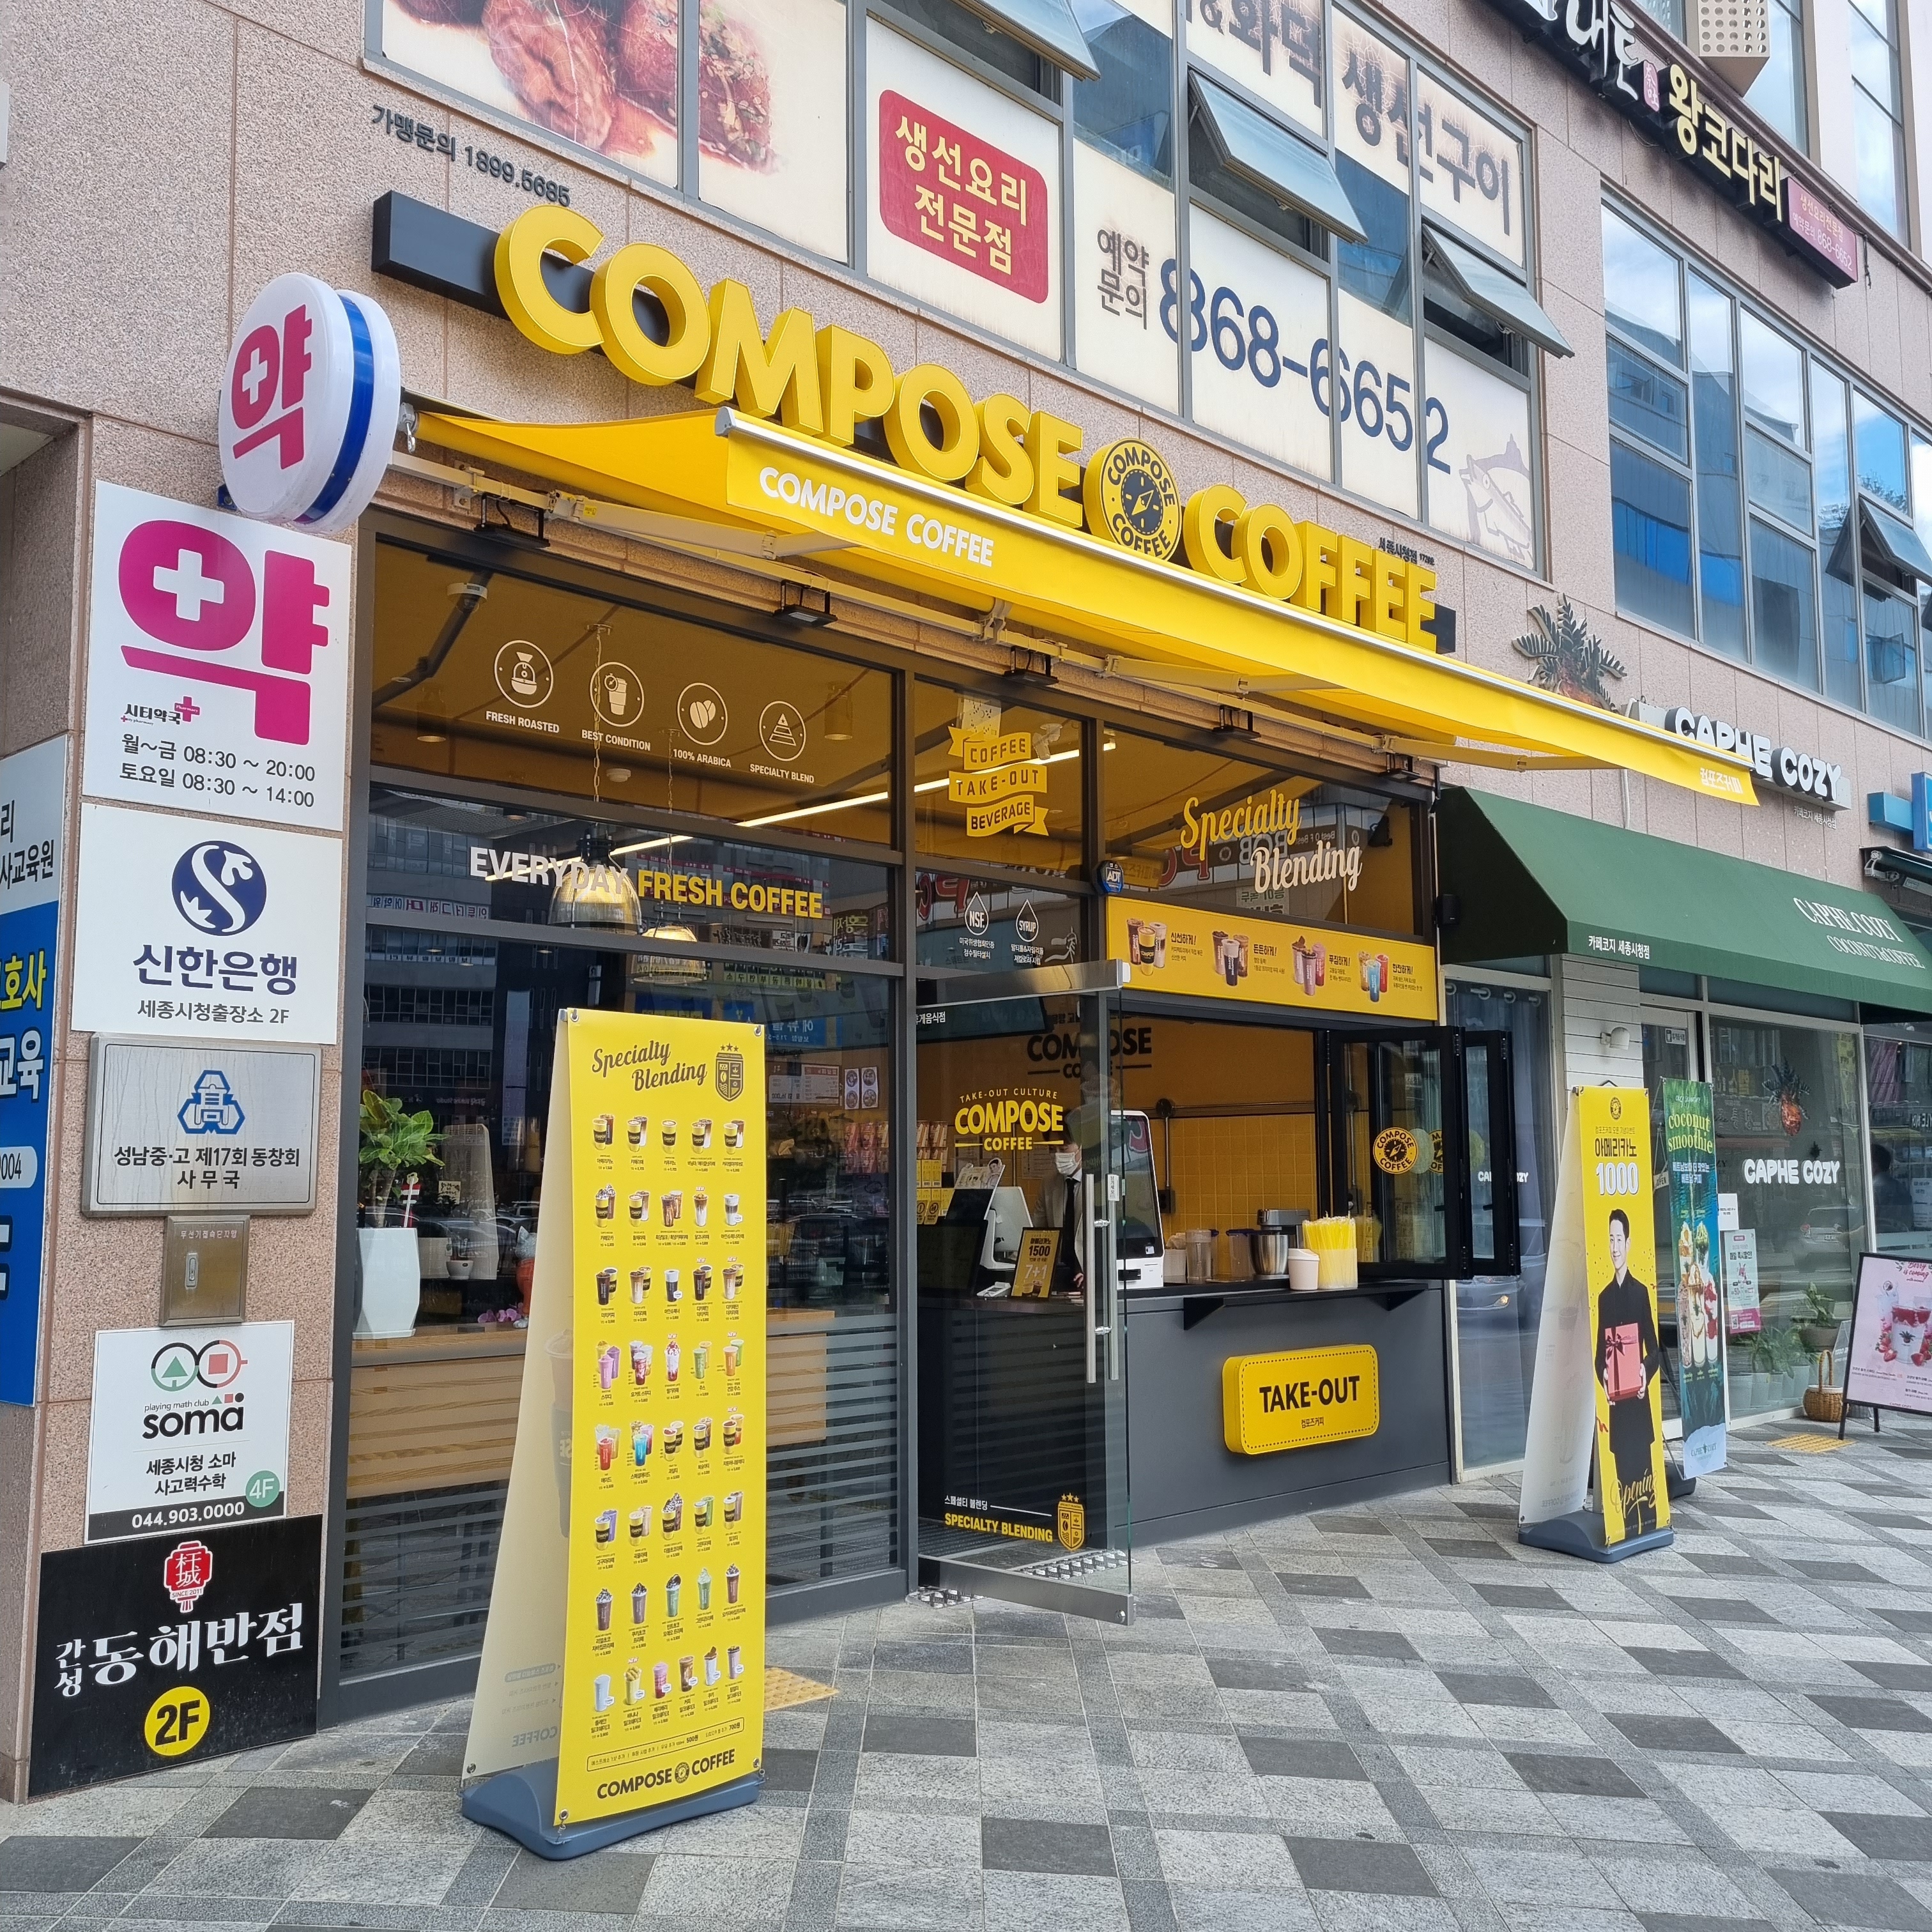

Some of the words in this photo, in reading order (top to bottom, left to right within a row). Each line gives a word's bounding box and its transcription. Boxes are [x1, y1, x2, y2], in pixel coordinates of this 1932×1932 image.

[372, 104, 456, 161] 가맹문의
[464, 145, 571, 207] 1899.5685
[1669, 64, 1782, 222] 왕코다리
[896, 116, 1027, 226] 생선요리
[915, 185, 1013, 275] 전문점
[1800, 194, 1843, 242] 생선요리전문점
[1097, 229, 1149, 281] 예약
[1793, 212, 1816, 241] 예약문의
[1818, 229, 1852, 271] 868-6652
[1097, 267, 1147, 330] 문의
[1159, 258, 1451, 474] 868-6652
[231, 304, 312, 470] 약
[494, 204, 1083, 530] COMPOSE
[1182, 484, 1437, 652] COFFEE
[1108, 446, 1176, 507] COMPOSE
[759, 466, 898, 535] COMPOSE
[906, 514, 994, 567] COFFEE
[1112, 513, 1171, 557] COFFEE
[118, 519, 330, 745] 약
[124, 703, 181, 725] 시티약국
[486, 710, 516, 726] FRESH
[518, 716, 560, 733] ROASTED
[581, 729, 604, 742] BEST
[605, 733, 651, 751] CONDITION
[970, 737, 1026, 763] COFFEE
[184, 746, 236, 769] 08:30
[266, 760, 315, 781] 20:00
[673, 749, 695, 762] 100%
[696, 753, 732, 768] ARABICA
[749, 763, 790, 781] SPECIALTY
[791, 772, 815, 783] BLEND
[119, 762, 175, 788] 토요일
[183, 773, 235, 795] 08:30
[266, 786, 314, 807] 14:00
[956, 769, 1039, 796] TAKE-OUT
[1700, 767, 1744, 794] 컴포즈커피
[1774, 747, 1841, 801] COZY
[970, 801, 1031, 830] BEVERAGE
[1179, 789, 1303, 861] Specialty
[1107, 870, 1121, 883] ADT
[1250, 841, 1363, 894] Blending
[470, 847, 629, 896] EVERYDAY
[638, 868, 723, 907] FRESH
[731, 882, 824, 919] COFFEE
[1019, 919, 1036, 933] SYRUP
[1793, 897, 1862, 933] CAPHE
[1850, 912, 1904, 942] COZY
[1254, 944, 1277, 956] 든든하게!
[1588, 935, 1616, 953] 카페코지
[1618, 939, 1650, 960] 세종시청점
[133, 944, 297, 995] 신한은행
[137, 1000, 264, 1023] 세종시청출장소
[269, 1009, 289, 1023] 2F
[592, 1040, 671, 1078] Specialty
[1027, 1027, 1152, 1062] COMOSE
[631, 1062, 708, 1091] Blending
[960, 1089, 1008, 1103] TAKE-OUT
[1014, 1088, 1058, 1100] CULTURE
[954, 1100, 1064, 1135] COMPOSE
[1668, 1113, 1711, 1132] coconut
[984, 1137, 1033, 1151] COFFEE
[1376, 1131, 1414, 1149] COMPOSE
[1595, 1138, 1637, 1157] 아메리카노
[1668, 1128, 1713, 1154] smoothie
[195, 1147, 247, 1167] 제17회
[251, 1147, 300, 1167] 동창회
[1379, 1158, 1413, 1172] COFFEE
[1744, 1158, 1799, 1184] CAPHE
[1803, 1160, 1840, 1184] COZY
[1596, 1162, 1639, 1195] 1000
[1029, 1245, 1051, 1257] 1500
[1025, 1264, 1048, 1280] 7+1
[144, 1402, 171, 1413] playing
[173, 1399, 192, 1408] math
[194, 1398, 210, 1407] club
[1259, 1375, 1360, 1413] TAKE-OUT
[142, 1406, 243, 1439] soma
[1300, 1416, 1324, 1429] 컴포즈커피
[146, 1452, 204, 1476] 세종시청
[208, 1452, 236, 1469] 소마
[154, 1473, 226, 1496] 사고력수학
[249, 1478, 275, 1500] 4F
[1610, 1468, 1658, 1519] Opening
[132, 1500, 245, 1529] 044.903.0000
[944, 1495, 968, 1508] 스페셜티
[970, 1498, 988, 1510] 블렌딩
[945, 1513, 999, 1533] SPECIALTY
[1001, 1522, 1053, 1542] BLENDING
[172, 1590, 188, 1598] SINCE
[189, 1588, 203, 1596] 2011
[89, 1603, 304, 1685] 동해반점
[155, 1698, 201, 1746] 2F
[597, 1768, 672, 1798] COMPOSE
[692, 1749, 735, 1775] COFFEE
